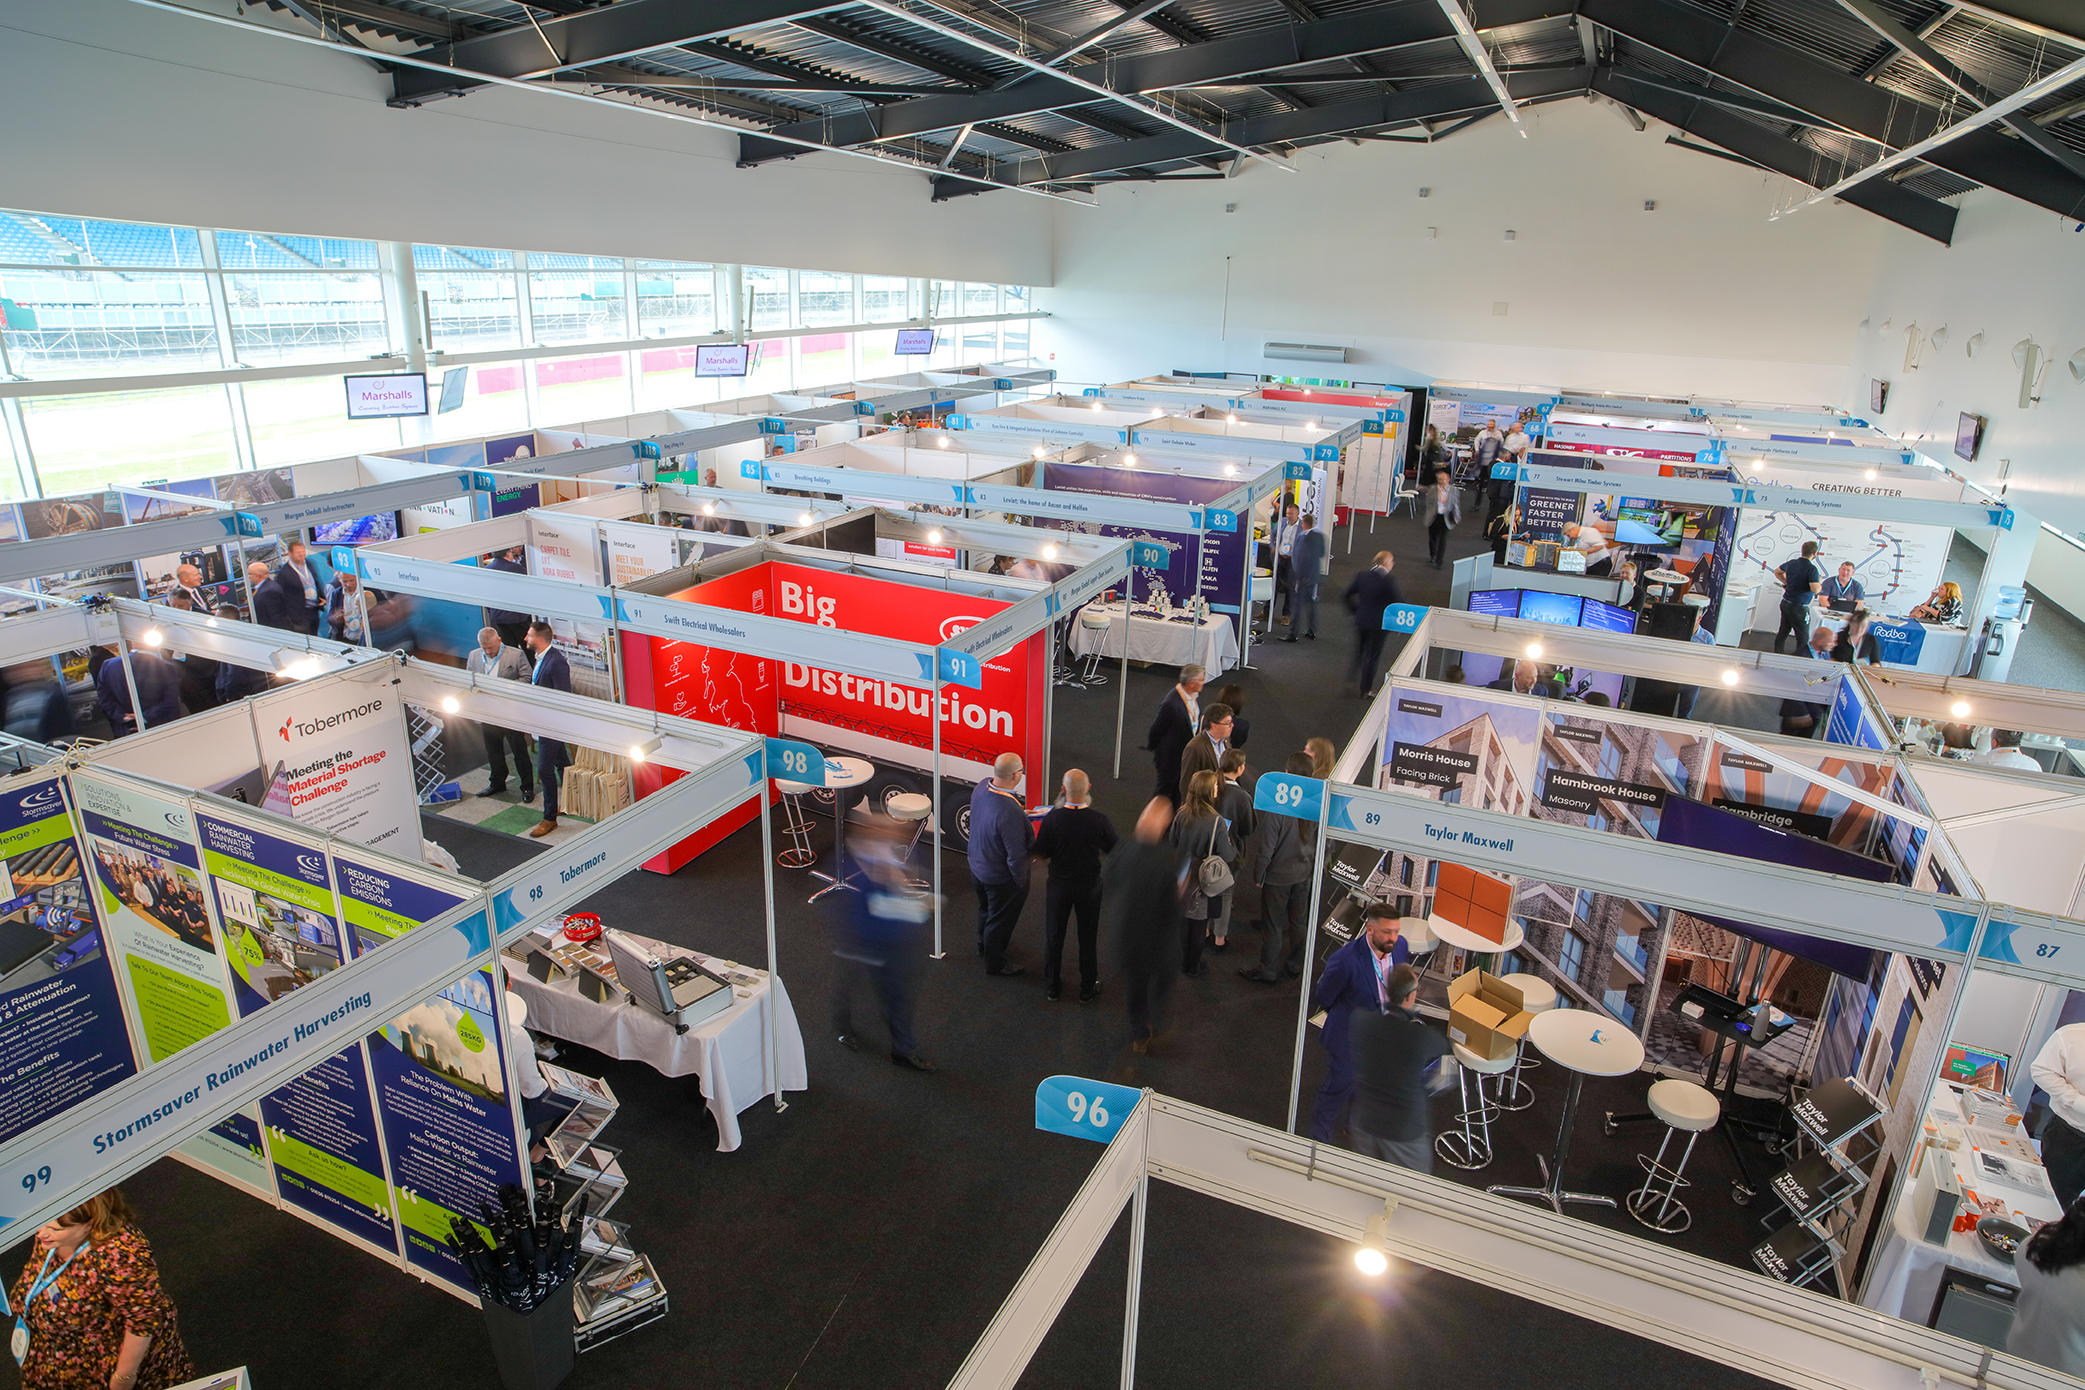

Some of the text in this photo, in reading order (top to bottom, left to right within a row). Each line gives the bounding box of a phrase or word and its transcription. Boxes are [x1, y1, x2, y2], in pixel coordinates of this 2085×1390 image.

[706, 356, 738, 365] Marshalls
[362, 390, 413, 401] Marshalls
[769, 422, 780, 430] 117
[952, 417, 959, 425] 81
[1369, 422, 1378, 430] 78
[1321, 449, 1332, 458] 79
[1660, 454, 1692, 462] PARTITIONS
[1702, 452, 1714, 462] 76
[746, 464, 755, 474] 85
[1292, 466, 1304, 476] 82
[1500, 466, 1510, 476] 77
[478, 474, 490, 487] 119
[794, 474, 832, 484] Breathing Buildings
[496, 492, 522, 502] ENERGY.
[1812, 482, 1902, 498] CREATING BETTER
[284, 502, 356, 521] Morgan Sindall Infrastructure
[1072, 504, 1088, 512] Halfen
[1530, 500, 1574, 510] GREENER
[1800, 499, 1820, 508] Flooring
[1821, 500, 1842, 508] Systems
[1214, 513, 1228, 526] 83
[1527, 518, 1564, 528] BETTER
[1528, 509, 1564, 519] FASTER
[242, 516, 257, 532] 120
[538, 530, 559, 539] Interface
[540, 544, 571, 558] CARPET TILE.
[614, 540, 636, 550] Interface
[338, 551, 349, 568] 93
[616, 554, 644, 566] MEET YOUR
[1144, 548, 1158, 563] 90
[374, 567, 420, 582] 93 Interface
[542, 568, 556, 576] NORA
[616, 564, 656, 576] SUSTAINABILITY
[781, 580, 836, 629] Big
[634, 610, 746, 638] 91 Swift Electrical Wholesalers
[1396, 610, 1416, 627] 88
[951, 658, 966, 678] 91
[784, 661, 1014, 738] Distribution
[294, 700, 382, 737] Tobermore
[1575, 731, 1596, 740] MAXWELL
[286, 750, 354, 782] Meeting the
[783, 749, 808, 773] 98
[1399, 748, 1472, 768] Morris House
[1727, 756, 1768, 768] TAYLOR MAXWELL
[288, 769, 336, 794] Material
[338, 750, 386, 776] Shortage
[1397, 766, 1450, 784] Facing Brick
[291, 778, 348, 806] Challenge
[1274, 782, 1303, 808] 89
[1552, 774, 1657, 802] Hambrook House
[22, 800, 62, 818] Stormsaver
[86, 792, 126, 811] INNOVATION
[88, 800, 122, 818] EXPERTISE
[1549, 794, 1591, 811] Masonry
[208, 822, 256, 845] COMMERCIAL
[209, 830, 252, 851] RAINWATER
[1366, 812, 1514, 852] 89 Taylor Maxwell
[210, 838, 256, 860] HARVESTING
[529, 849, 606, 902] 98 Tobermore
[1332, 866, 1360, 882] Maxwell
[1337, 860, 1358, 874] Taylor
[222, 866, 302, 903] Tackling Global Water
[232, 862, 304, 894] Meeting The Challenge
[347, 867, 390, 889] REDUCING
[349, 877, 384, 896] CARBON
[351, 886, 392, 908] EMISSIONS
[374, 910, 404, 929] Meeting
[1329, 917, 1350, 932] Taylor
[1325, 922, 1352, 940] Maxwell
[244, 948, 262, 962] 75%
[2035, 944, 2061, 959] 87
[5, 983, 77, 1019] & Attenuation
[11, 979, 64, 1007] Rainwater
[460, 1030, 482, 1044] 285KG
[17, 1050, 60, 1076] Benefits
[93, 1087, 200, 1155] Stormsaver
[205, 1036, 291, 1092] Rainwater
[294, 989, 372, 1042] Harvesting
[410, 1070, 474, 1103] The Problem With
[400, 1074, 487, 1118] Reliance On Mains Water
[1067, 1090, 1109, 1128] 96
[1802, 1098, 1828, 1124] Taylor
[1794, 1102, 1828, 1136] Maxwell
[410, 1132, 498, 1176] Mains Water vs Rainwater
[424, 1130, 480, 1160] Carbon Output:
[308, 1150, 347, 1172] Ask us how?
[22, 1166, 52, 1194] 99
[1783, 1172, 1810, 1200] Taylor
[1774, 1177, 1808, 1212] Maxwell
[1755, 1248, 1788, 1283] Maxwell
[1763, 1242, 1789, 1272] Taylor
